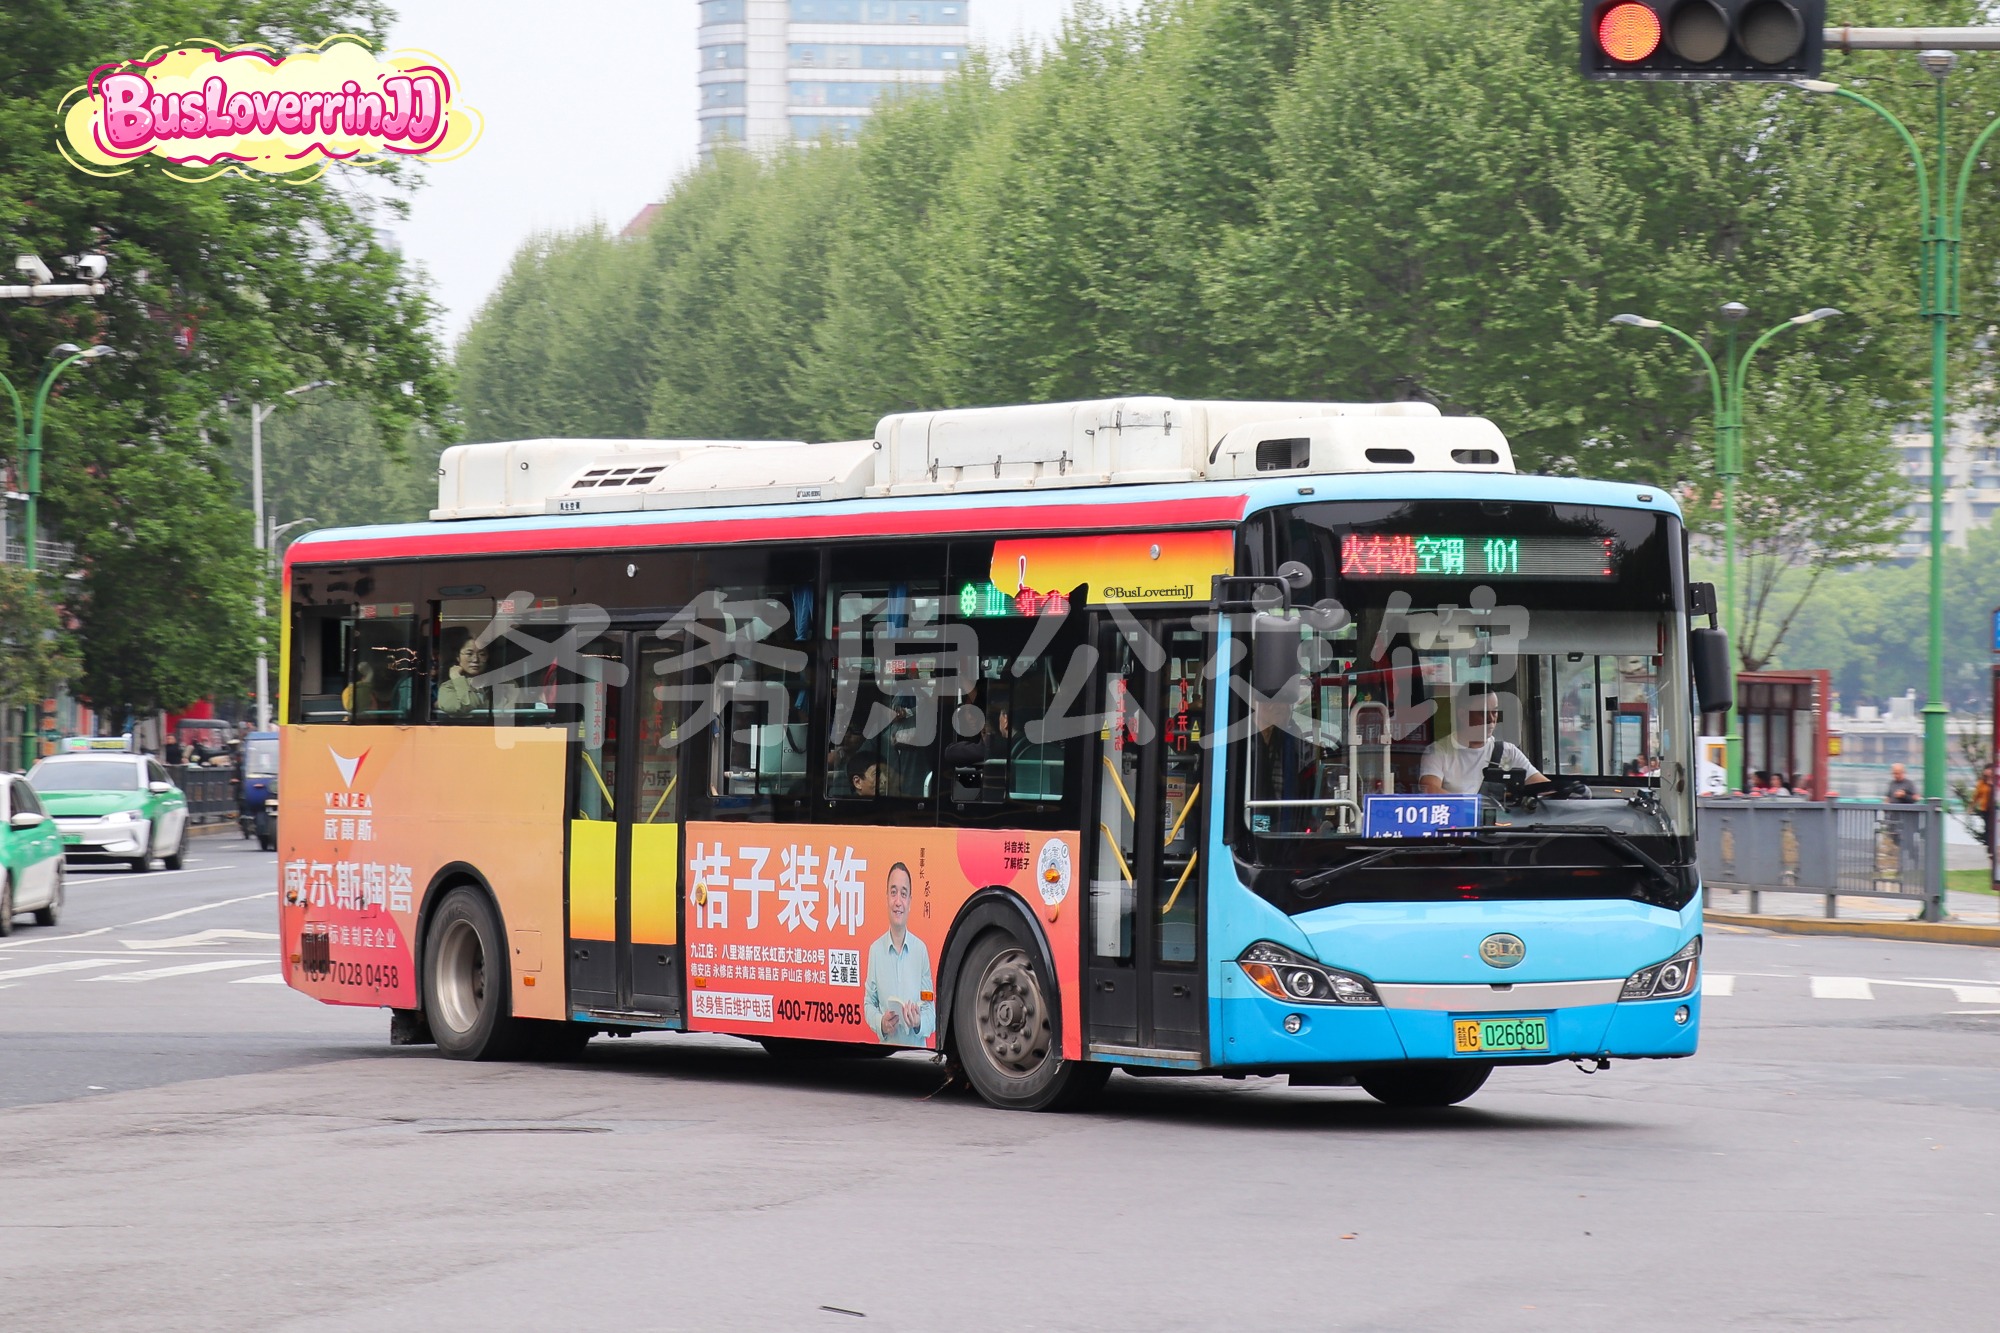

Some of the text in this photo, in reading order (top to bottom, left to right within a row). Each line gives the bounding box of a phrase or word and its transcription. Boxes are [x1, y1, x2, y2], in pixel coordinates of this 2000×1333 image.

[325, 792, 372, 808] VENIZEA
[1394, 804, 1450, 825] 101路
[1004, 841, 1030, 854] 抖音关注
[1004, 857, 1030, 870] 了解桔子
[284, 858, 413, 914] 威尔斯陶瓷
[690, 842, 867, 936] 桔子装饰
[830, 953, 858, 966] 九江县区
[830, 966, 858, 984] 全覆盖
[695, 994, 771, 1018] 终身售后维护电话
[777, 999, 862, 1026] 400-7788-985
